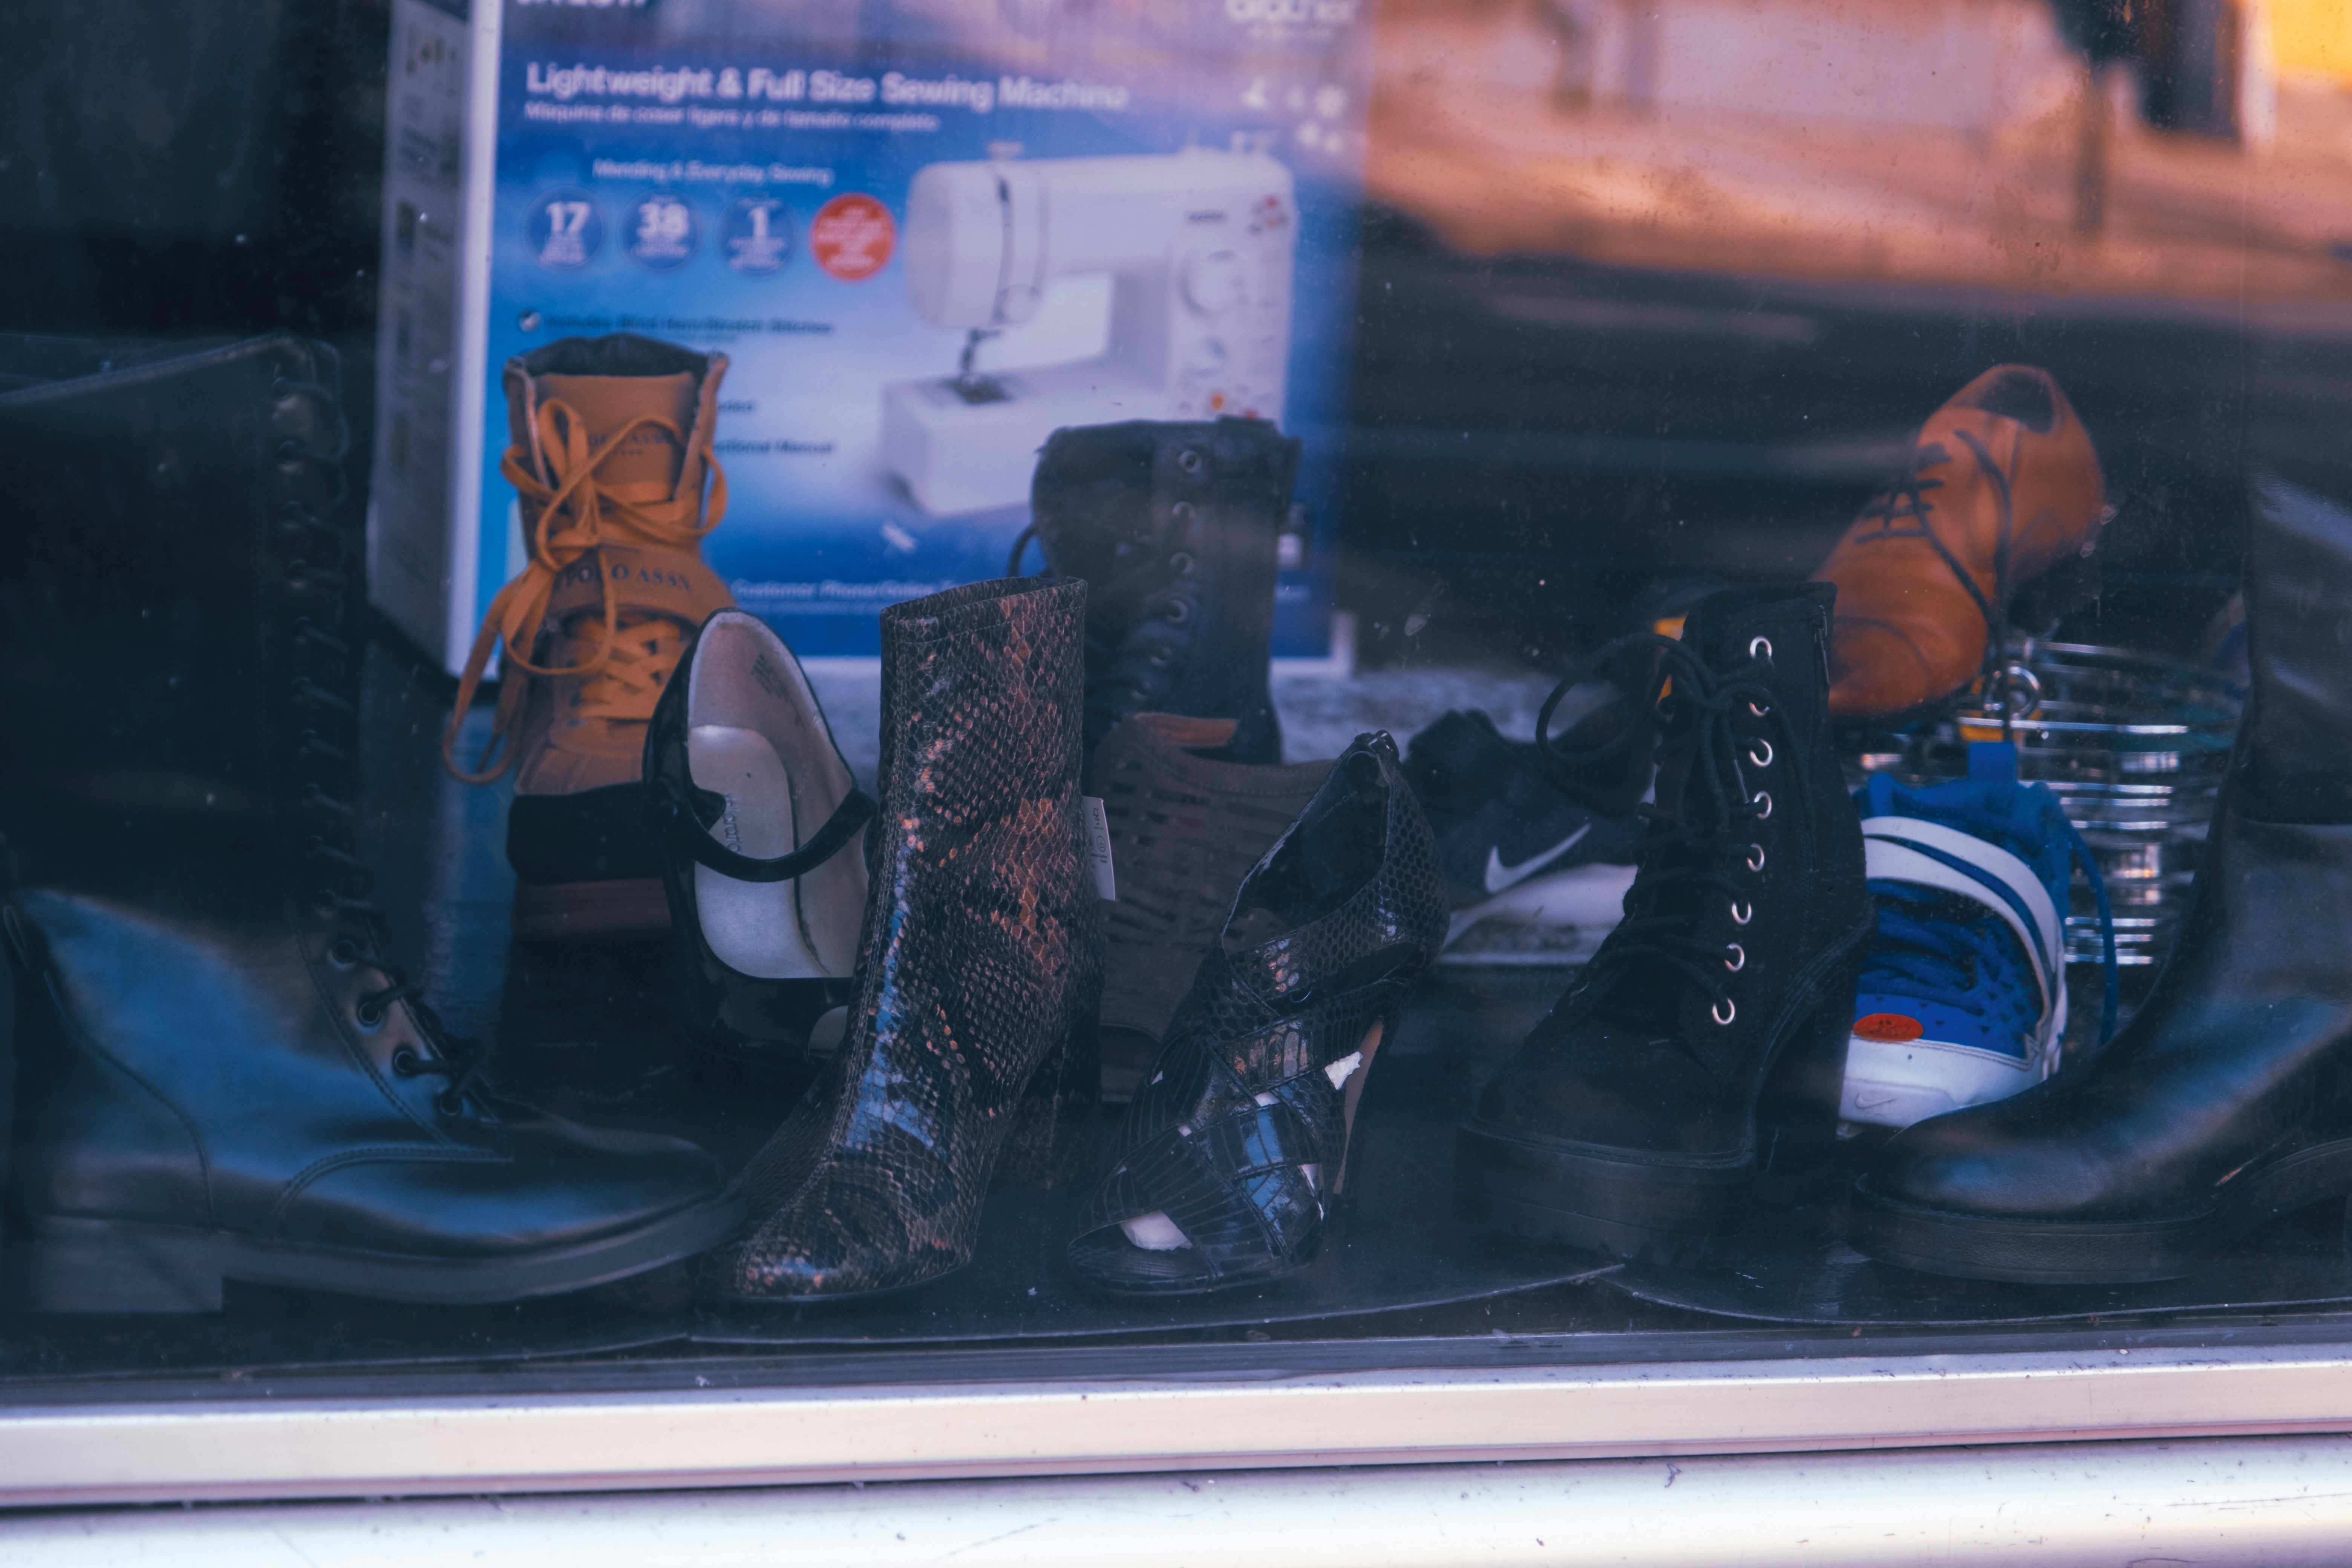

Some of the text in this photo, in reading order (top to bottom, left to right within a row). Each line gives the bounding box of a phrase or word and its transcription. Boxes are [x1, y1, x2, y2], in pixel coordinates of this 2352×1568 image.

[526, 61, 1129, 112] Lightweight & Full Size Sewing Machine
[767, 162, 835, 189] Sewing
[546, 201, 591, 233] 17
[637, 203, 689, 238] 38
[747, 206, 769, 237] 1
